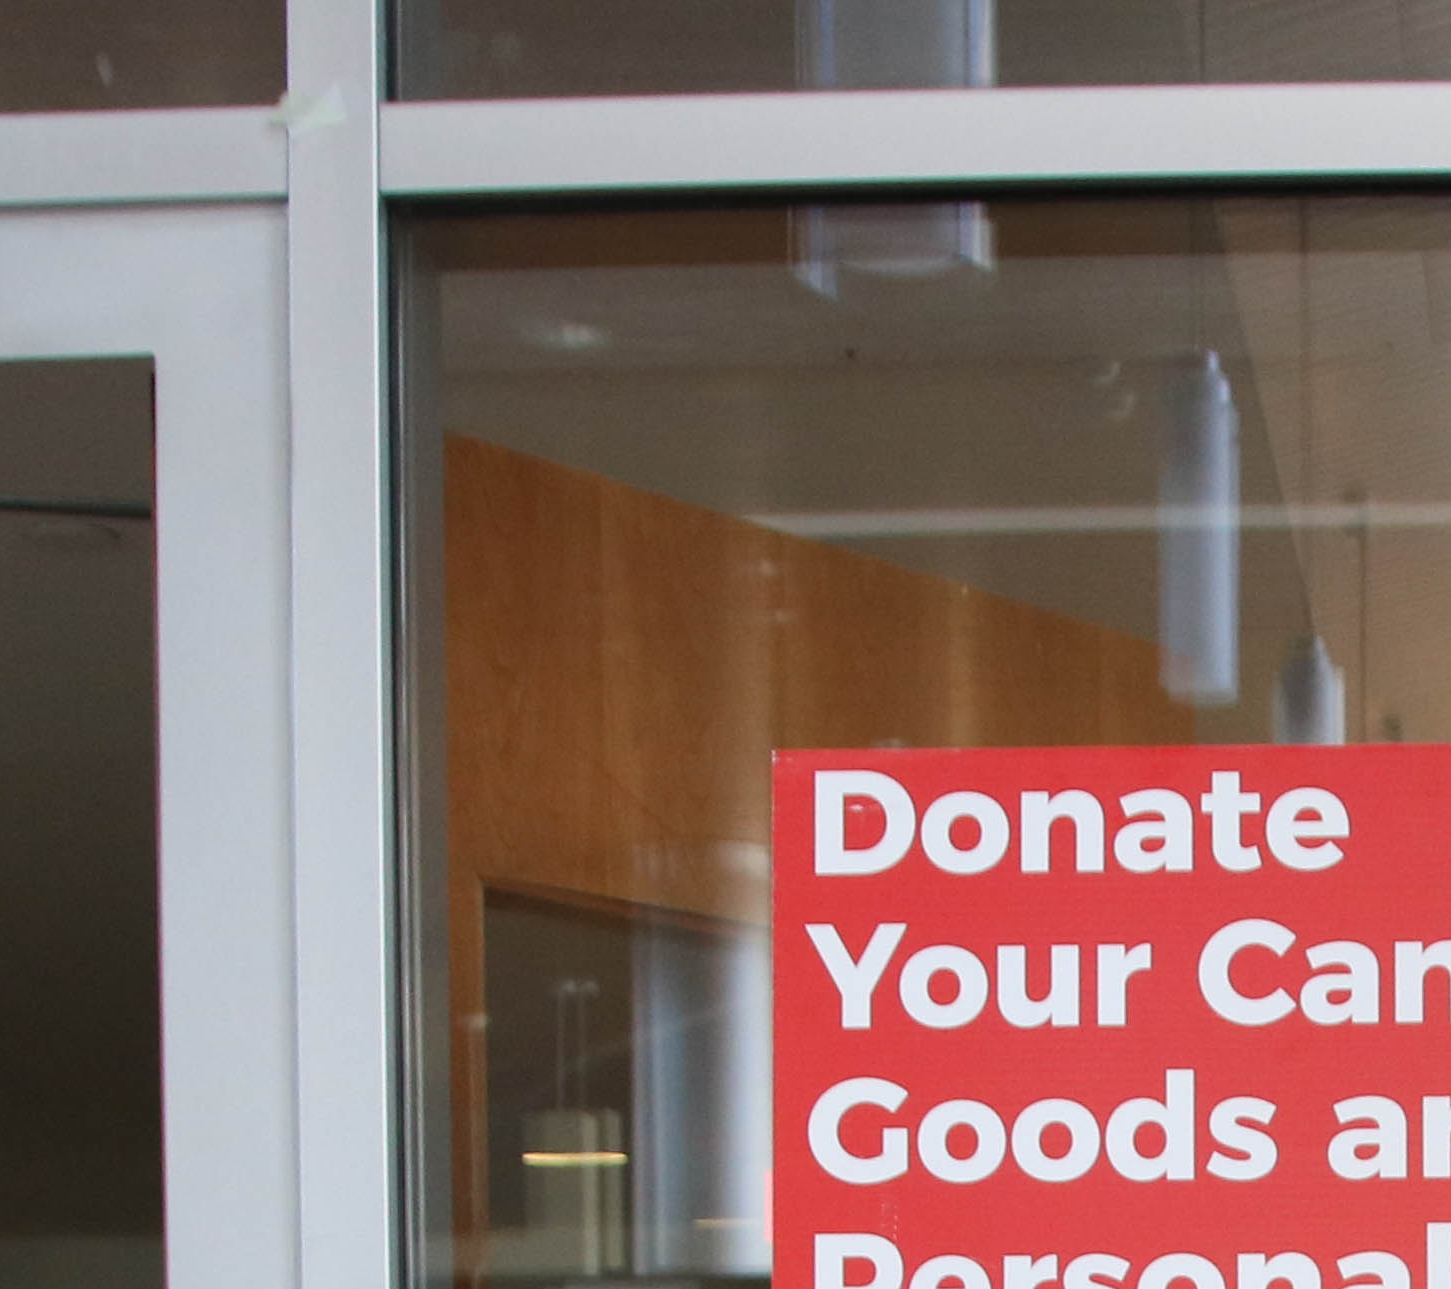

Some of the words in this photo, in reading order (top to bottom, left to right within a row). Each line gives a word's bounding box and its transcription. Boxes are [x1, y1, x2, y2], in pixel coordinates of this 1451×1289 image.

[814, 770, 1350, 875] Donate
[806, 923, 1151, 1029] Your
[807, 1069, 1277, 1184] Goods
